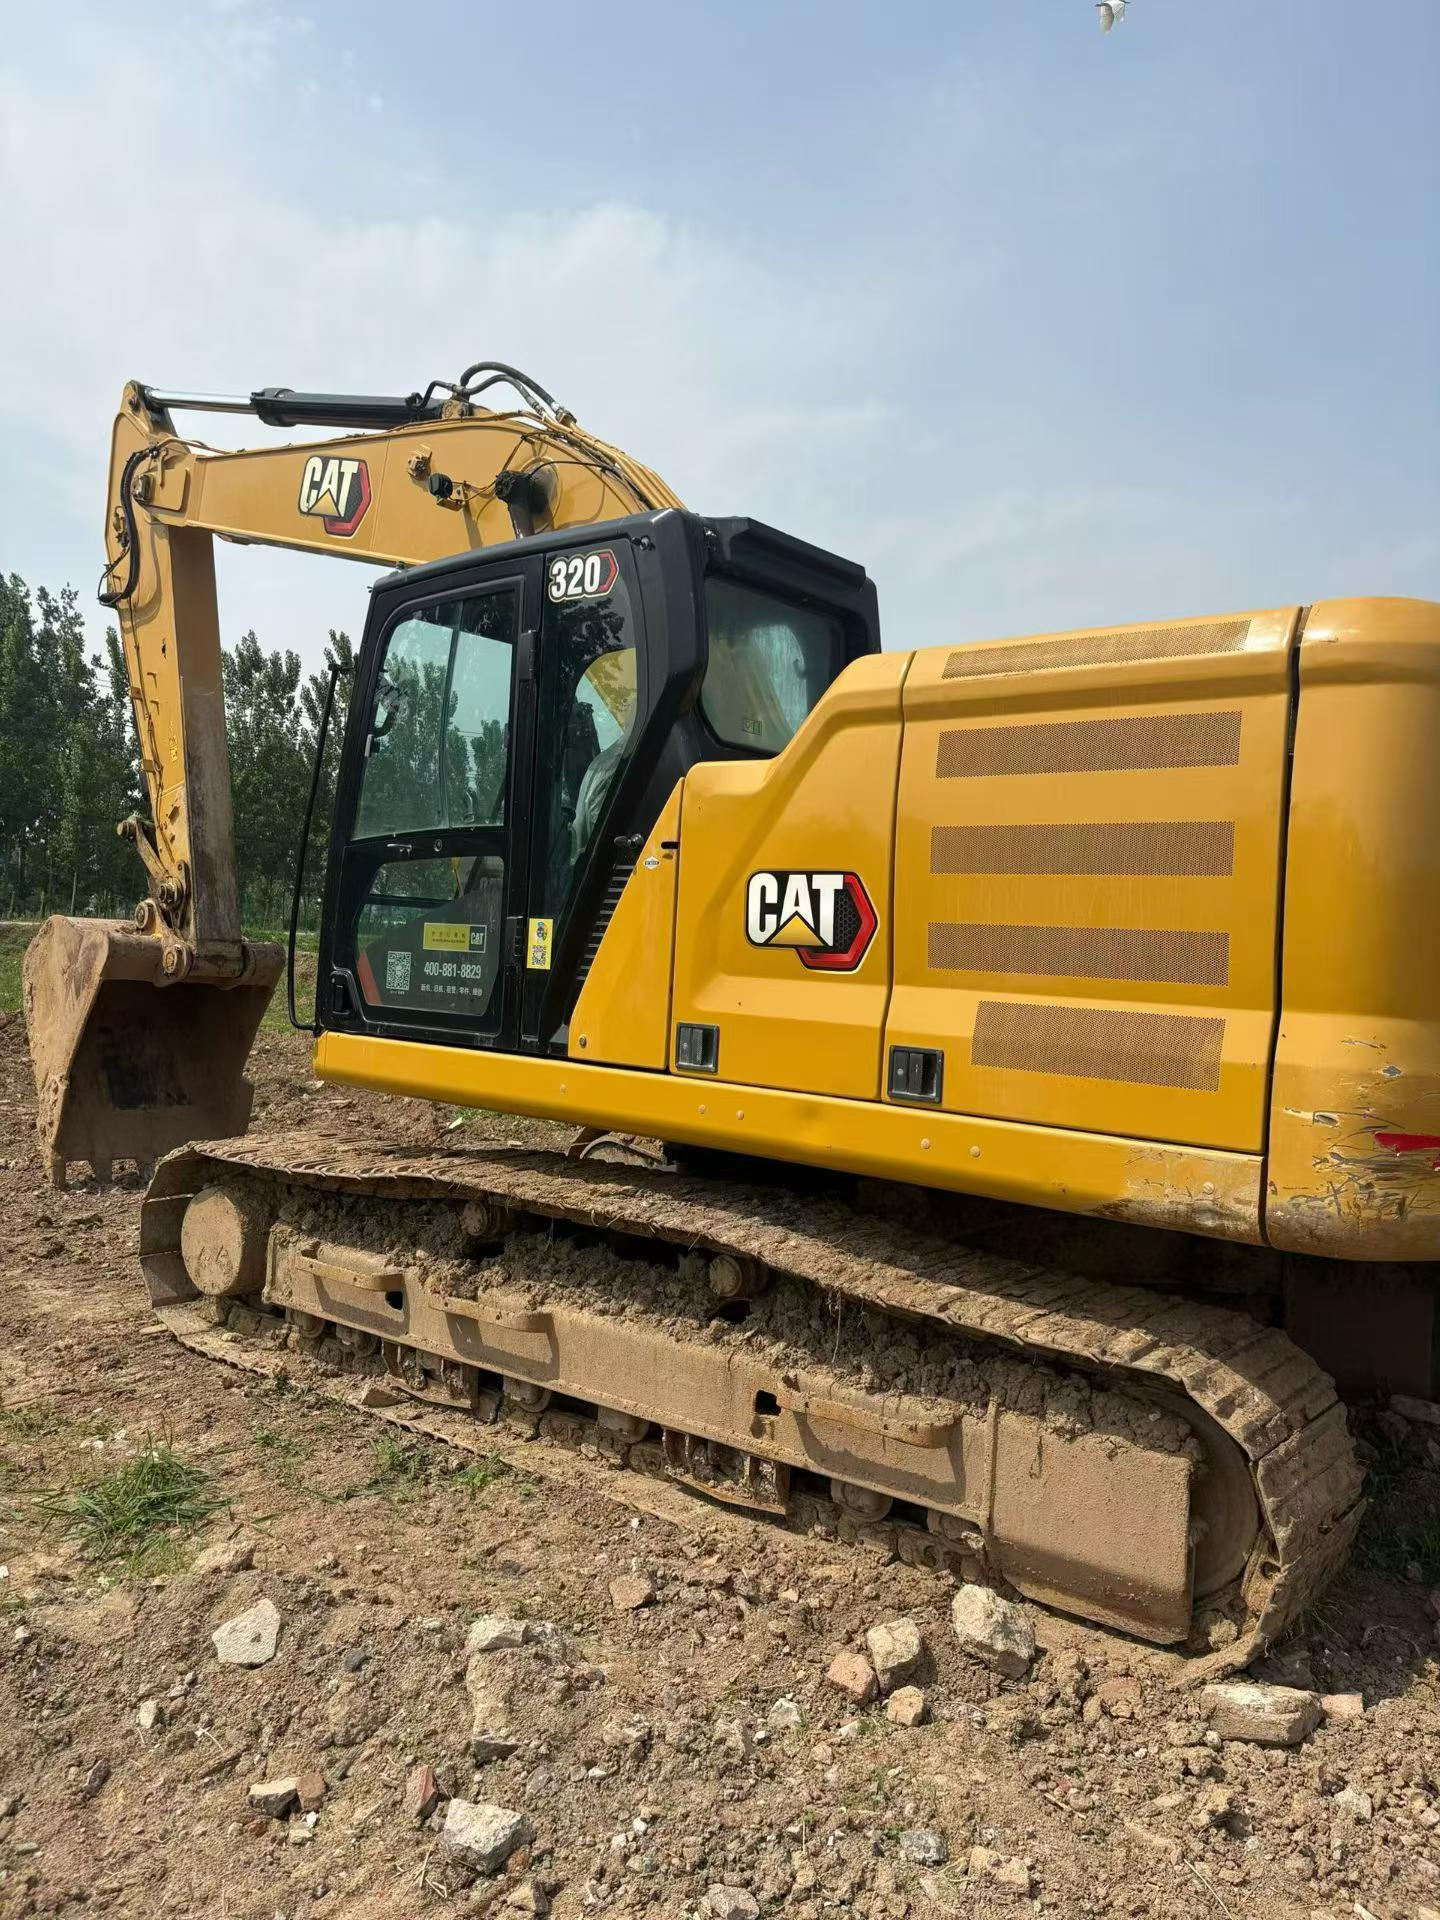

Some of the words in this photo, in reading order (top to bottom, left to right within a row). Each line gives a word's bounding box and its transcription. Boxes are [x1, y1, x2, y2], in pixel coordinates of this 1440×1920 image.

[299, 456, 359, 517] CAT
[551, 555, 601, 598] 320
[747, 872, 844, 947] CAT
[470, 932, 484, 945] CAT
[424, 961, 482, 979] 400-881-8829
